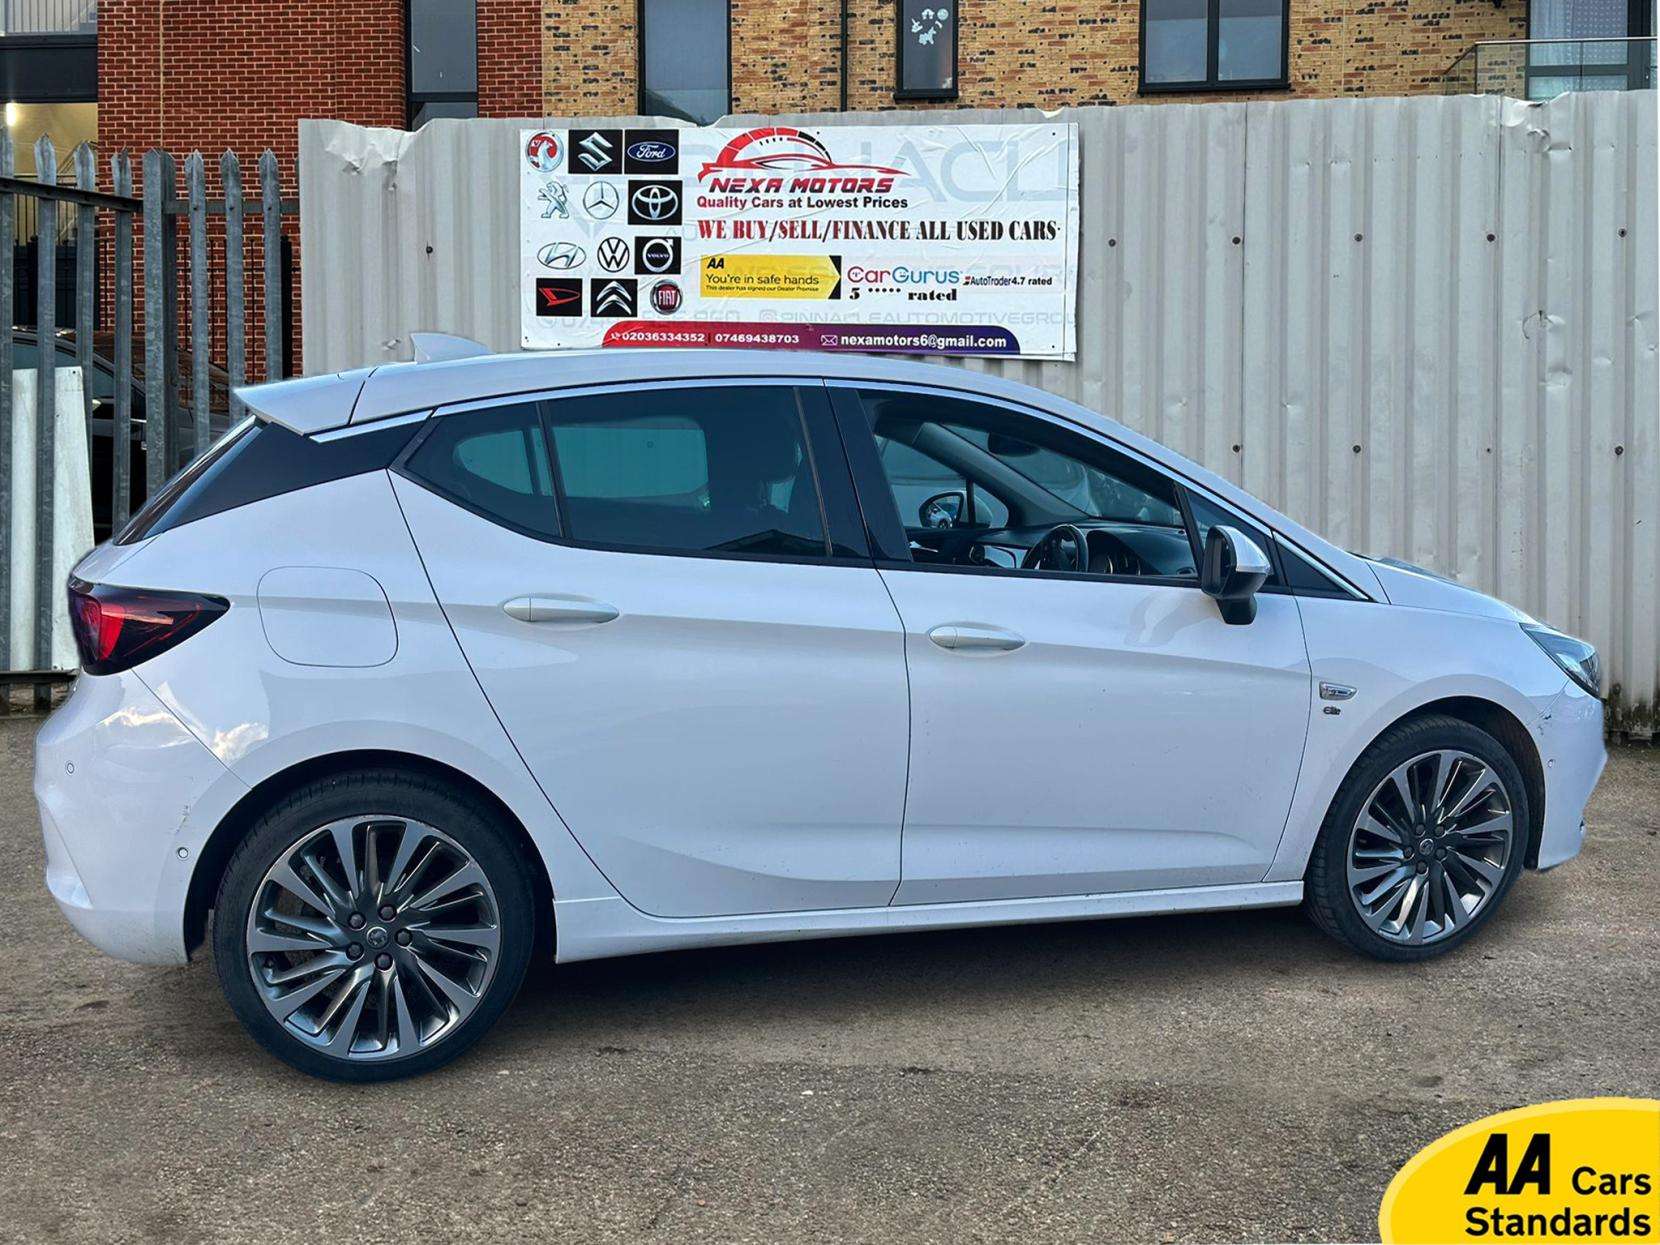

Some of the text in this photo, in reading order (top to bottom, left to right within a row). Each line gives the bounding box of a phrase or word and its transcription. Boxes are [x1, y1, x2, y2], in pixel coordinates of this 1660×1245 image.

[636, 144, 665, 159] Ford
[709, 178, 895, 193] NEXA MOTORS
[697, 196, 908, 210] Quality Cars at Lowest Prices
[698, 220, 726, 239] WE
[733, 219, 911, 242] BUY/SELL/FINANCE
[917, 220, 950, 240] ALL
[956, 220, 1004, 240] USED
[1008, 220, 1057, 241] CARS
[706, 257, 725, 269] AA
[706, 273, 819, 285] You're in safe hands
[847, 266, 960, 285] CarGurus
[1028, 277, 1053, 286] rated
[658, 290, 677, 306] FIAT
[849, 287, 957, 301] 5 rated
[622, 333, 800, 344] 02036334352 07469438703
[841, 334, 1007, 350] nexamotors6@gmail.com
